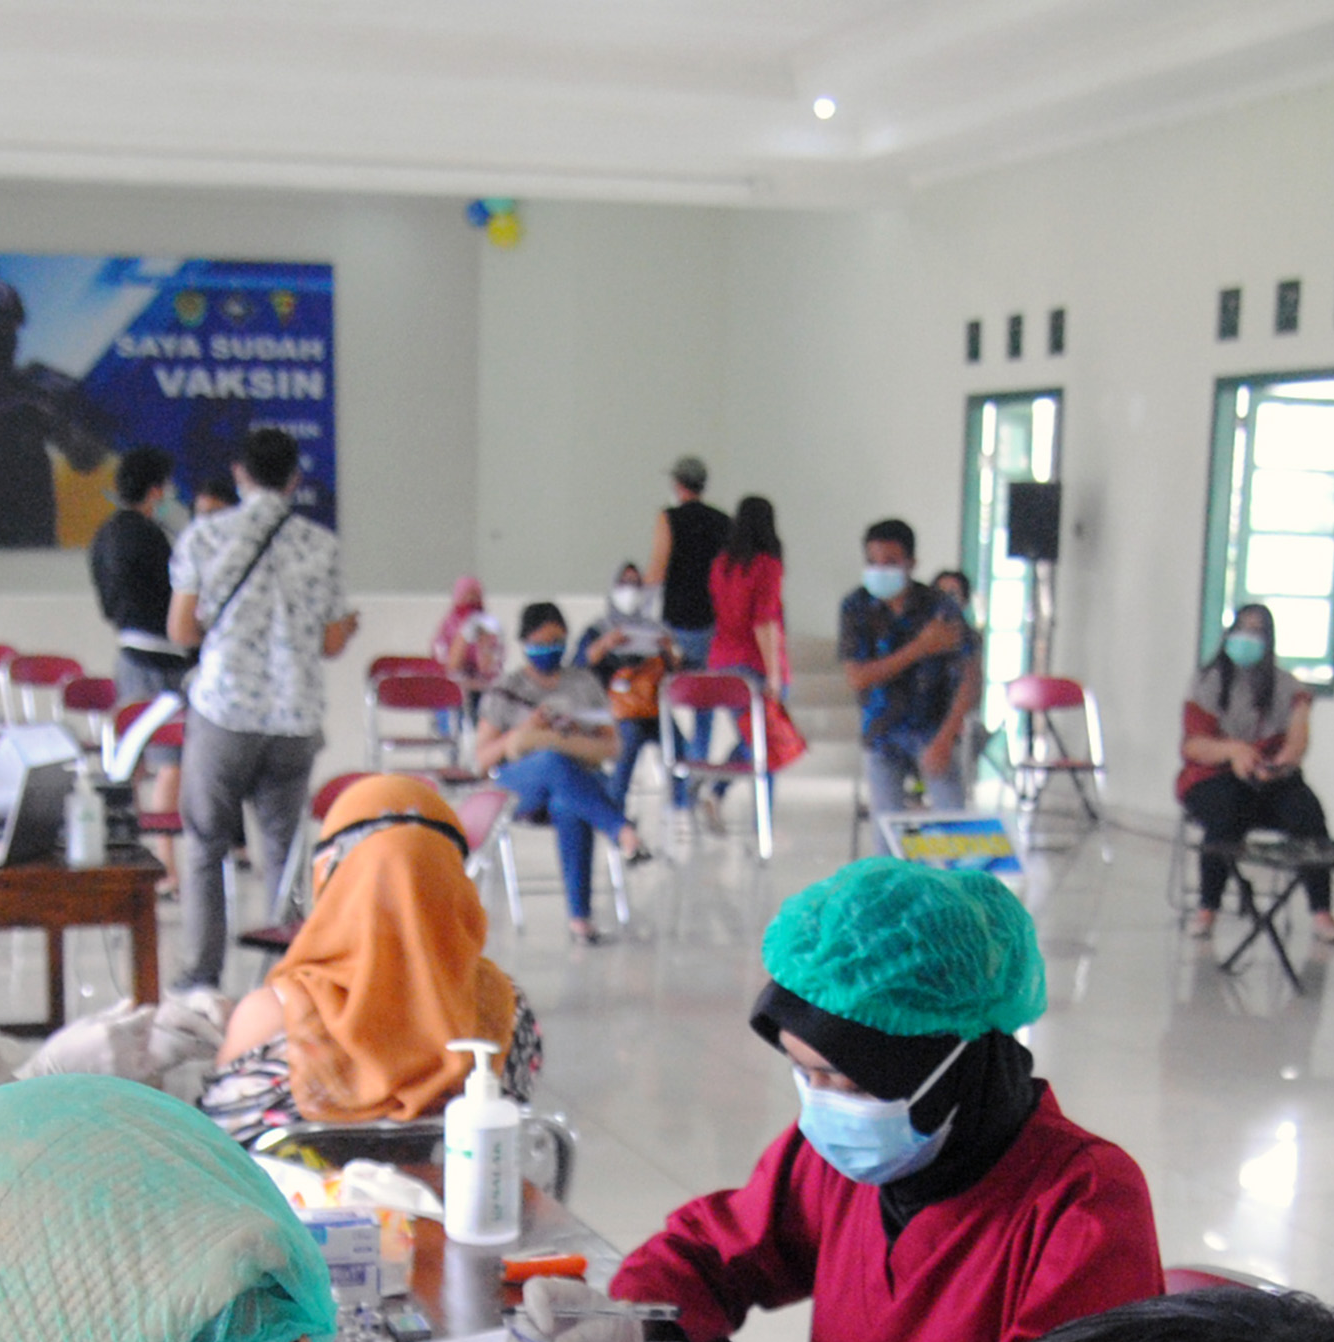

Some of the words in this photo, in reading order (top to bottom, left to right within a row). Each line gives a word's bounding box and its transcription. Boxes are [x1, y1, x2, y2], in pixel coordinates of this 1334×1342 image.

[116, 333, 203, 360] SAYA
[210, 333, 326, 362] SUDAH
[153, 364, 326, 399] VAKSIN
